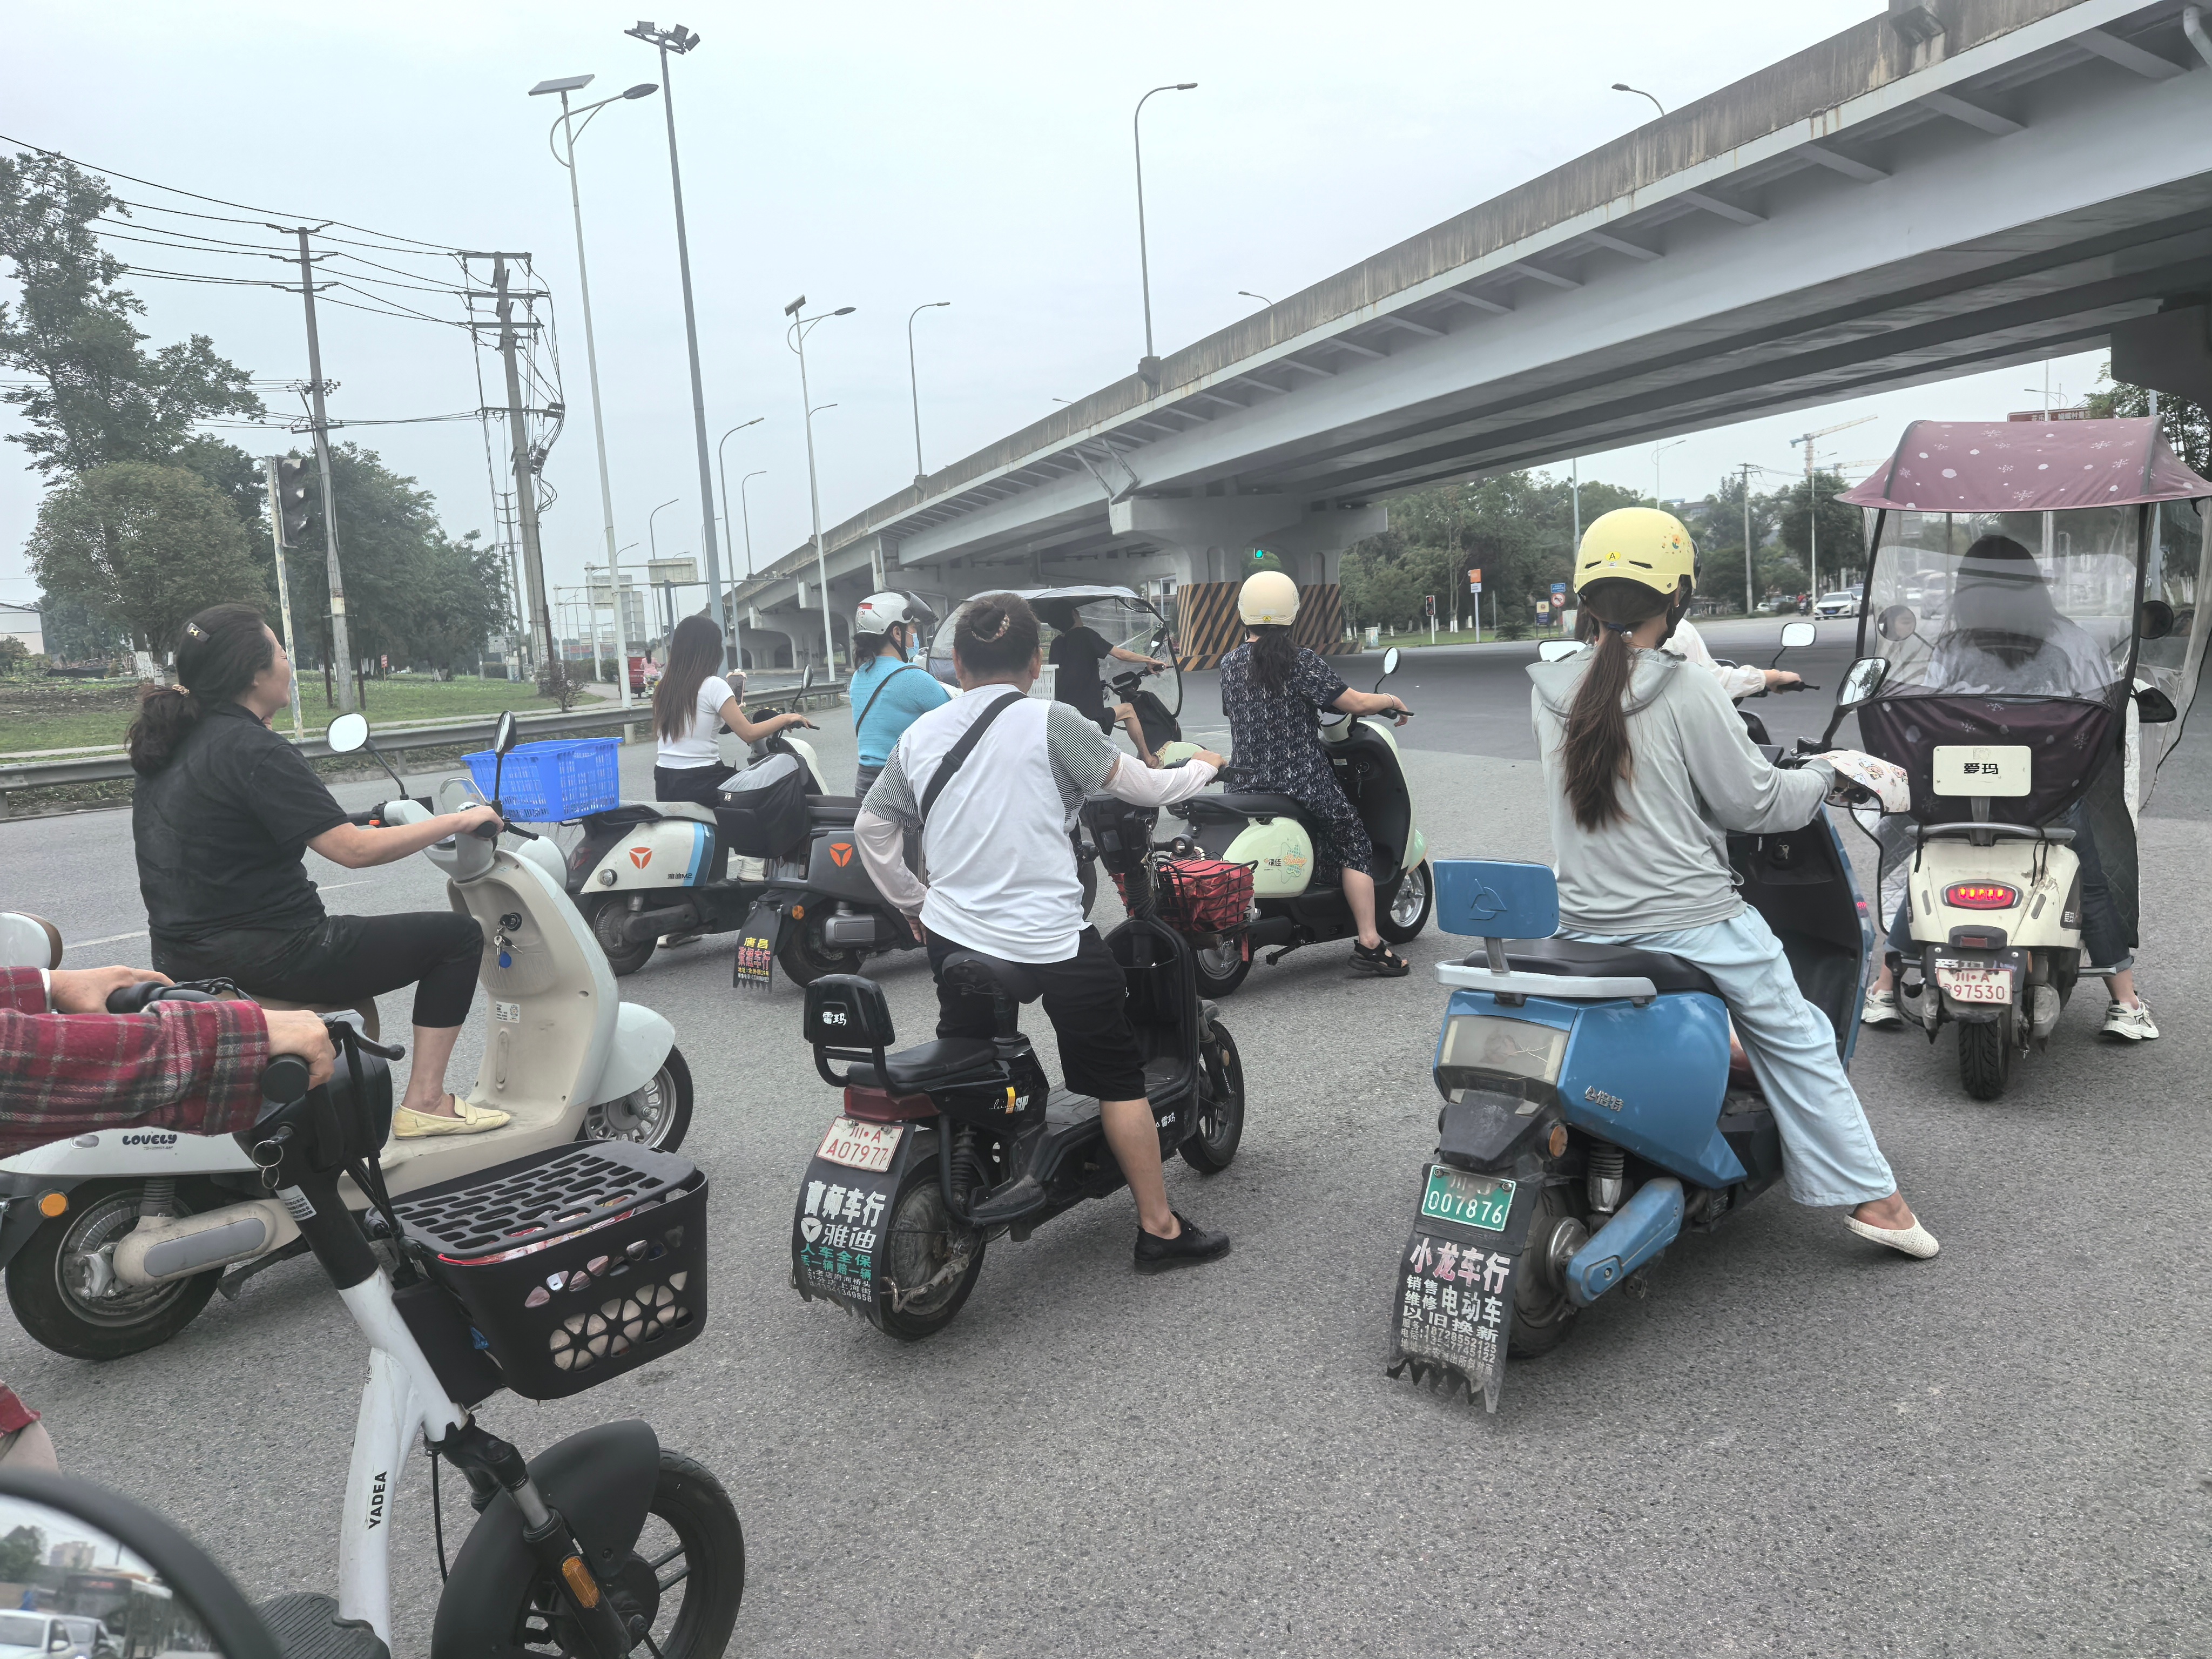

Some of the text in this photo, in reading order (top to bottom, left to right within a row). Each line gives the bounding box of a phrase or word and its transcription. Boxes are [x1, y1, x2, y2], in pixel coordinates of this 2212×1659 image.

[1964, 763, 1999, 774] 爱玛
[744, 937, 768, 949] 唐昌
[822, 1011, 847, 1026] 雷玛
[122, 1134, 177, 1145] LOVELY
[826, 1139, 889, 1166] A07977
[1428, 1191, 1503, 1224] 007876
[821, 1223, 876, 1253] 雅迪
[800, 1243, 872, 1268] 人车全保
[801, 1255, 872, 1282] 丢一辆赔一辆
[1410, 1238, 1510, 1294] 小龙车行
[1407, 1274, 1438, 1296] 销售
[1405, 1285, 1502, 1328] 维修 电动车
[1403, 1305, 1499, 1343] 以旧换新
[1424, 1325, 1497, 1353] 18728552125
[368, 1471, 387, 1529] YADEA
